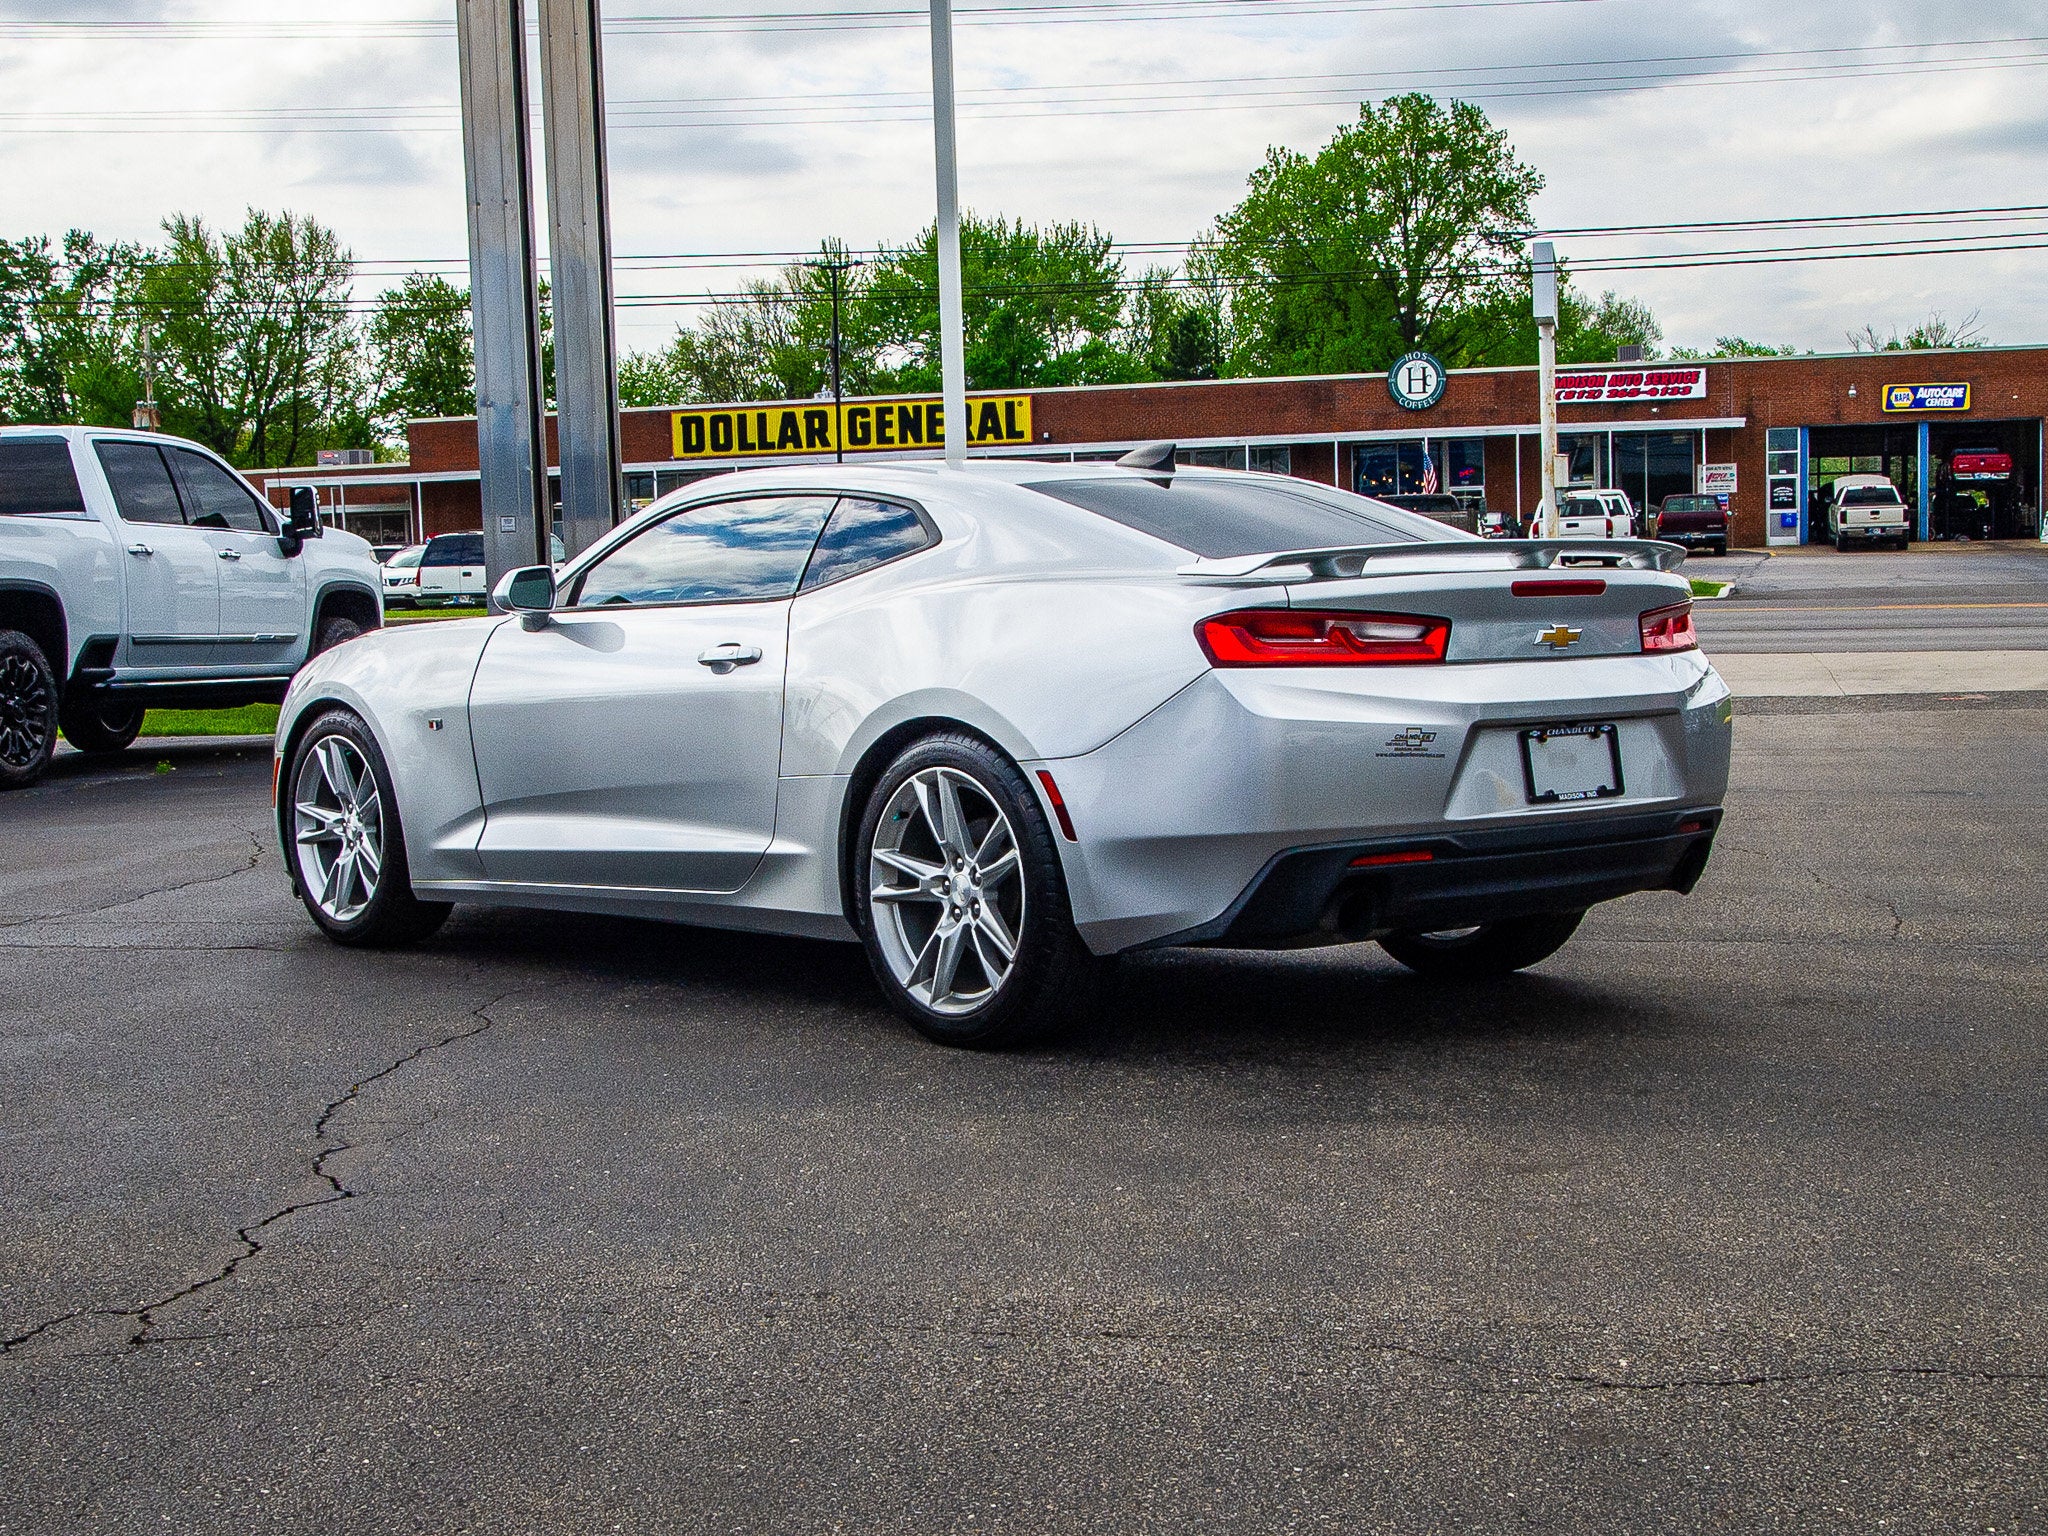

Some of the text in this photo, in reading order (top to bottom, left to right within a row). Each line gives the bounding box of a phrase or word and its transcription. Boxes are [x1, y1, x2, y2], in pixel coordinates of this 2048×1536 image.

[1404, 351, 1428, 361] HOS
[1608, 373, 1643, 387] AUTO
[1644, 371, 1701, 386] SERVICE
[1398, 397, 1436, 409] COFFEE
[1925, 398, 1954, 407] CENTER
[680, 409, 831, 454] DOLLAR
[1546, 726, 1595, 736] CHANDLER
[1558, 792, 1585, 801] MADISON
